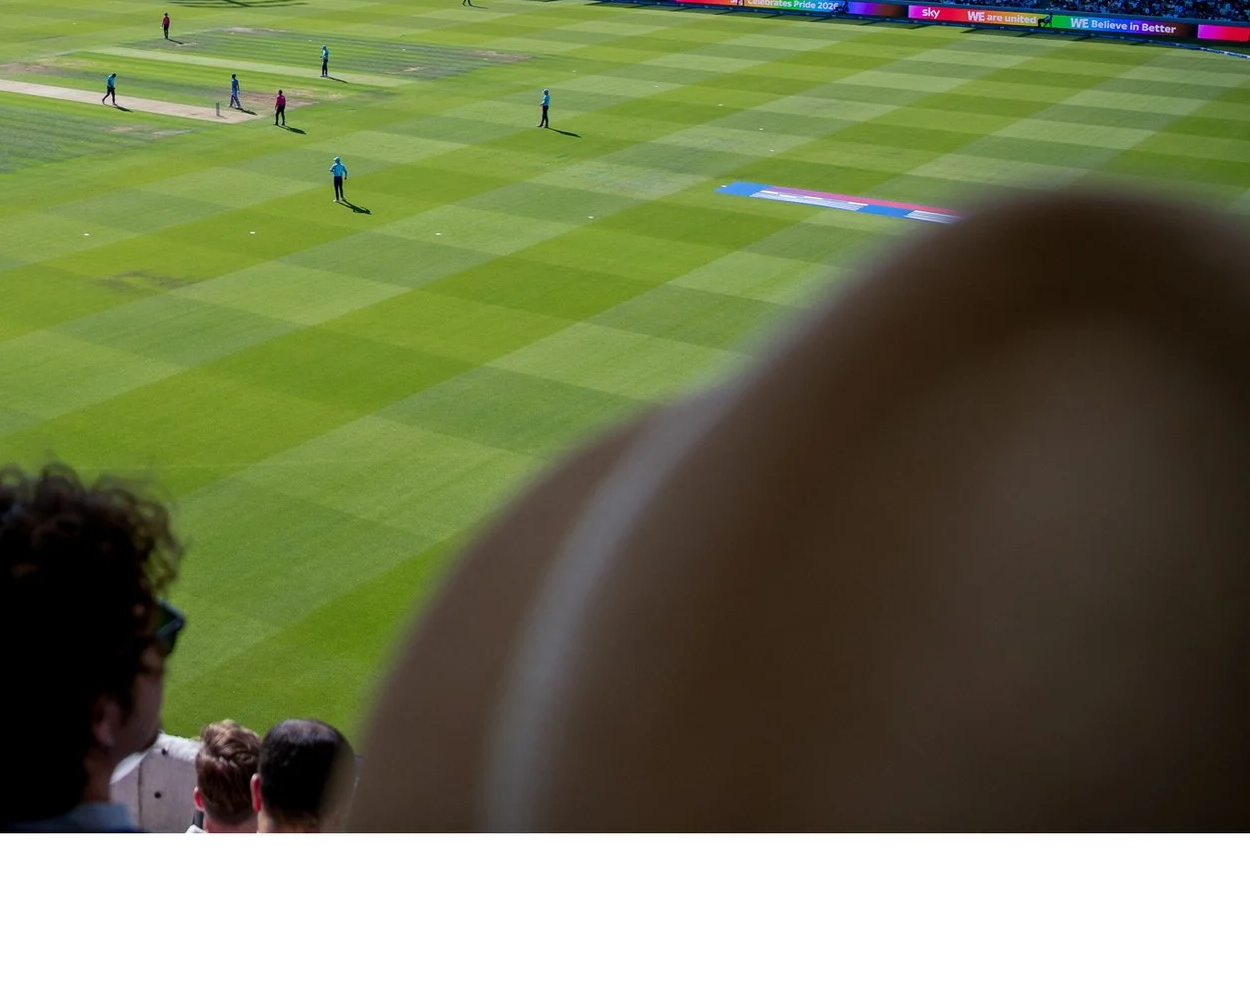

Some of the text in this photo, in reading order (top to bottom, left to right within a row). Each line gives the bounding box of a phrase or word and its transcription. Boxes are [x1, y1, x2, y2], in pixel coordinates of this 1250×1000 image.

[794, 0, 816, 8] Pride
[922, 7, 940, 19] sky
[967, 11, 984, 21] WE
[1004, 14, 1036, 24] united
[1070, 18, 1176, 34] WE Believe in Better
